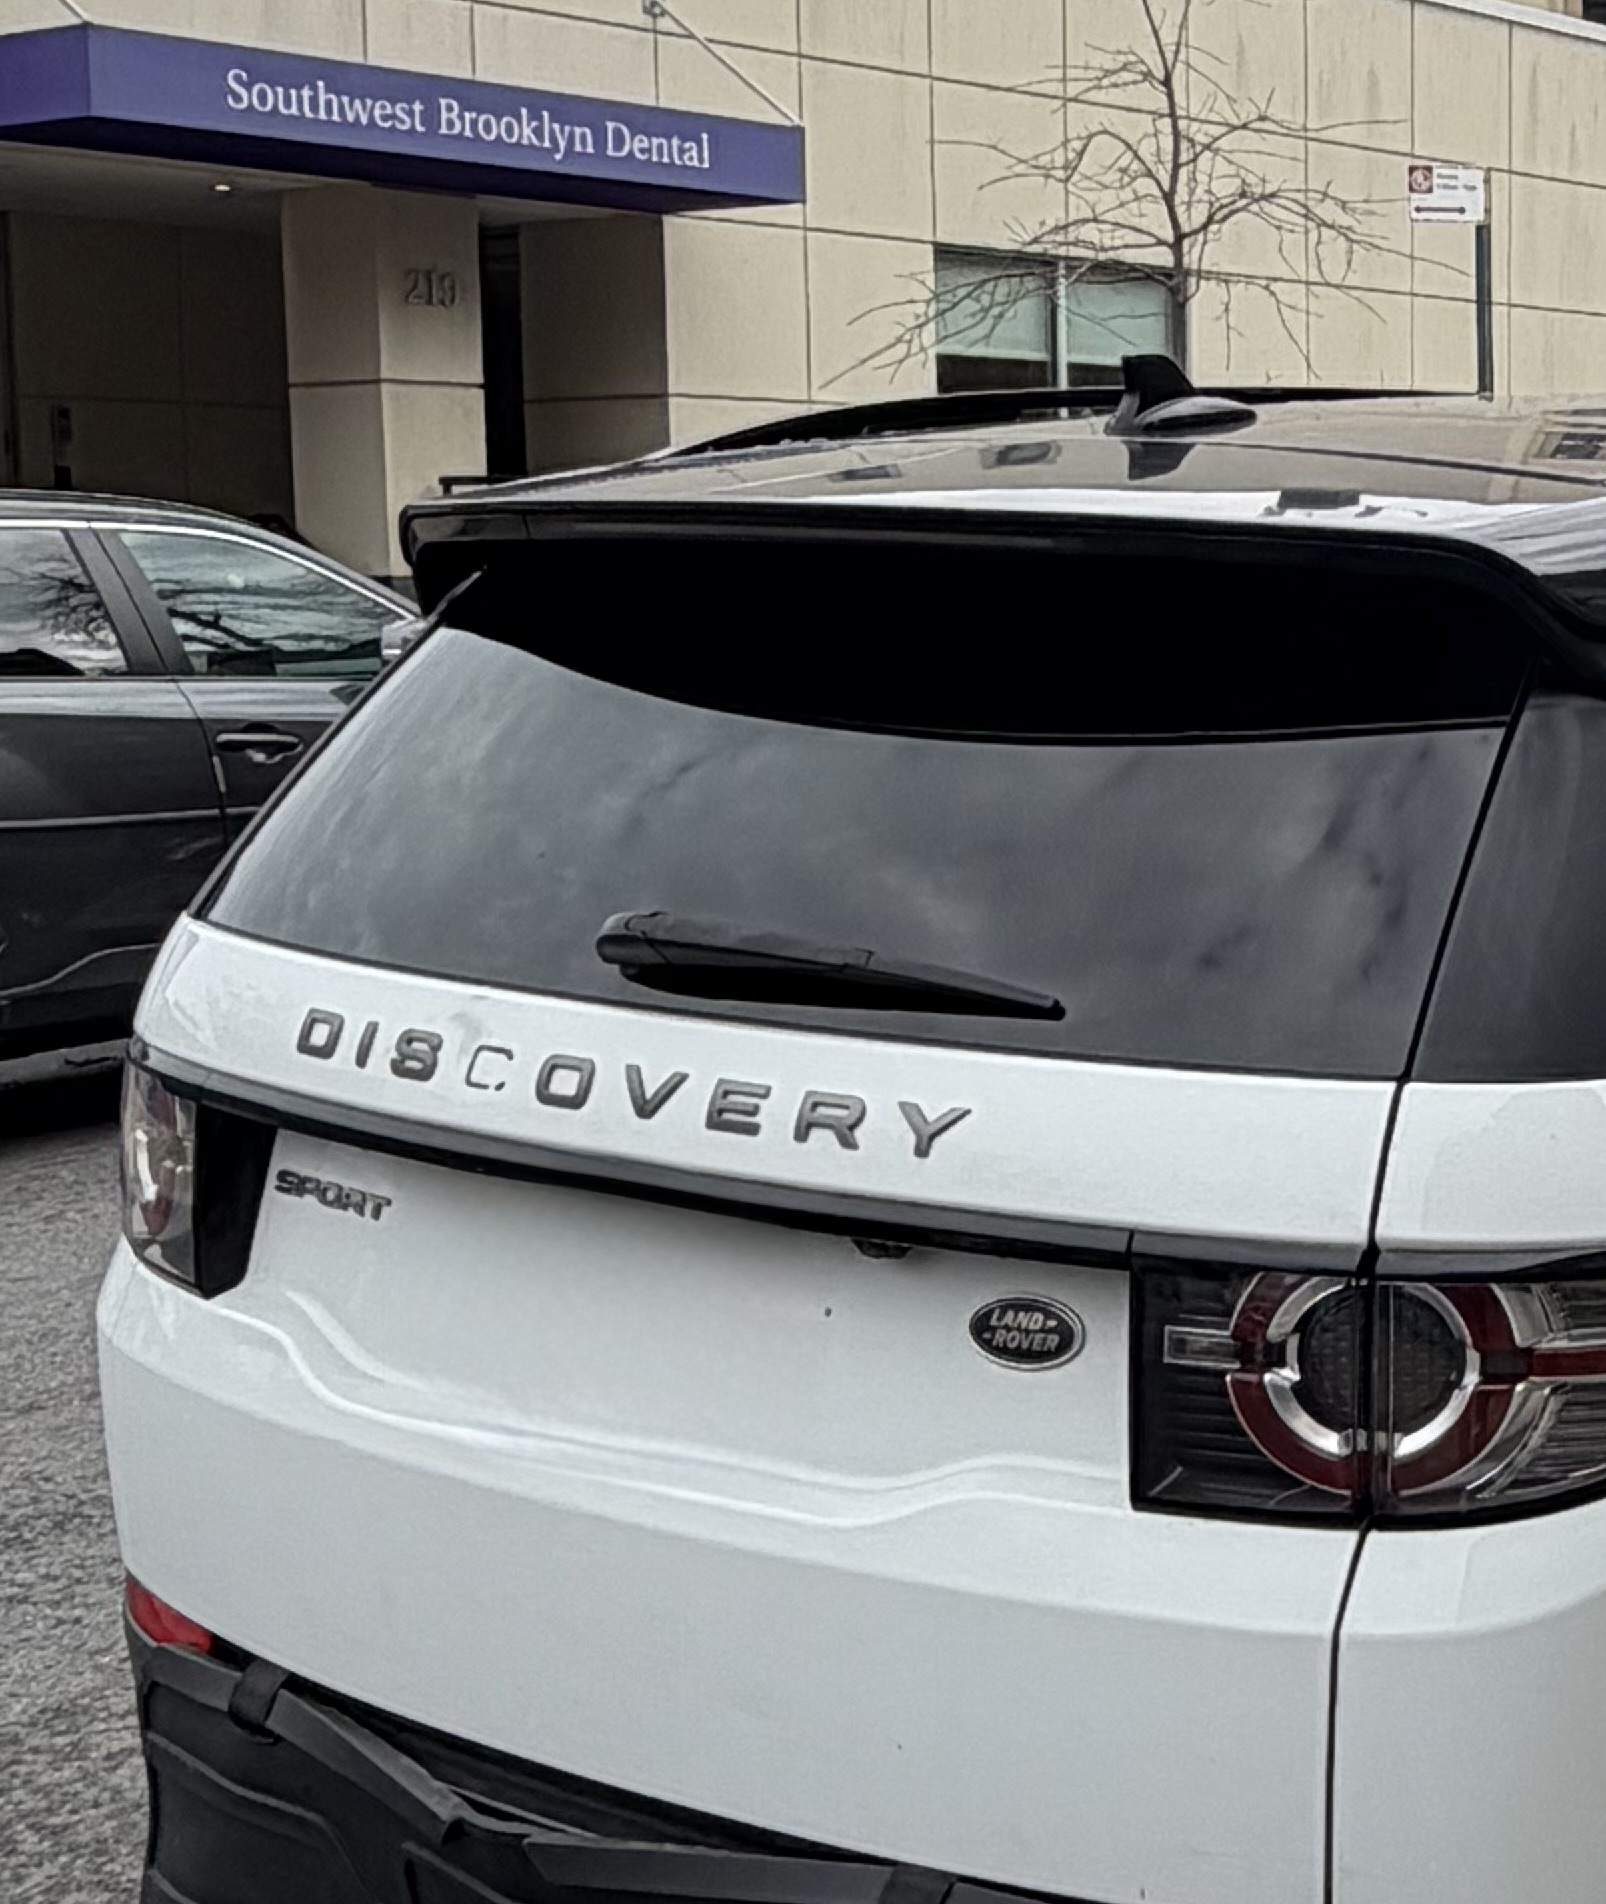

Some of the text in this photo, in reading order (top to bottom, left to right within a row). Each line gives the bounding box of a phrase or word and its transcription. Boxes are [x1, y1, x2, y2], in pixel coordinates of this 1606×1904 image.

[226, 68, 711, 169] Southwest Brooklyn Dental
[296, 1007, 972, 1159] DISCOVERY
[274, 1169, 393, 1222] SPORT
